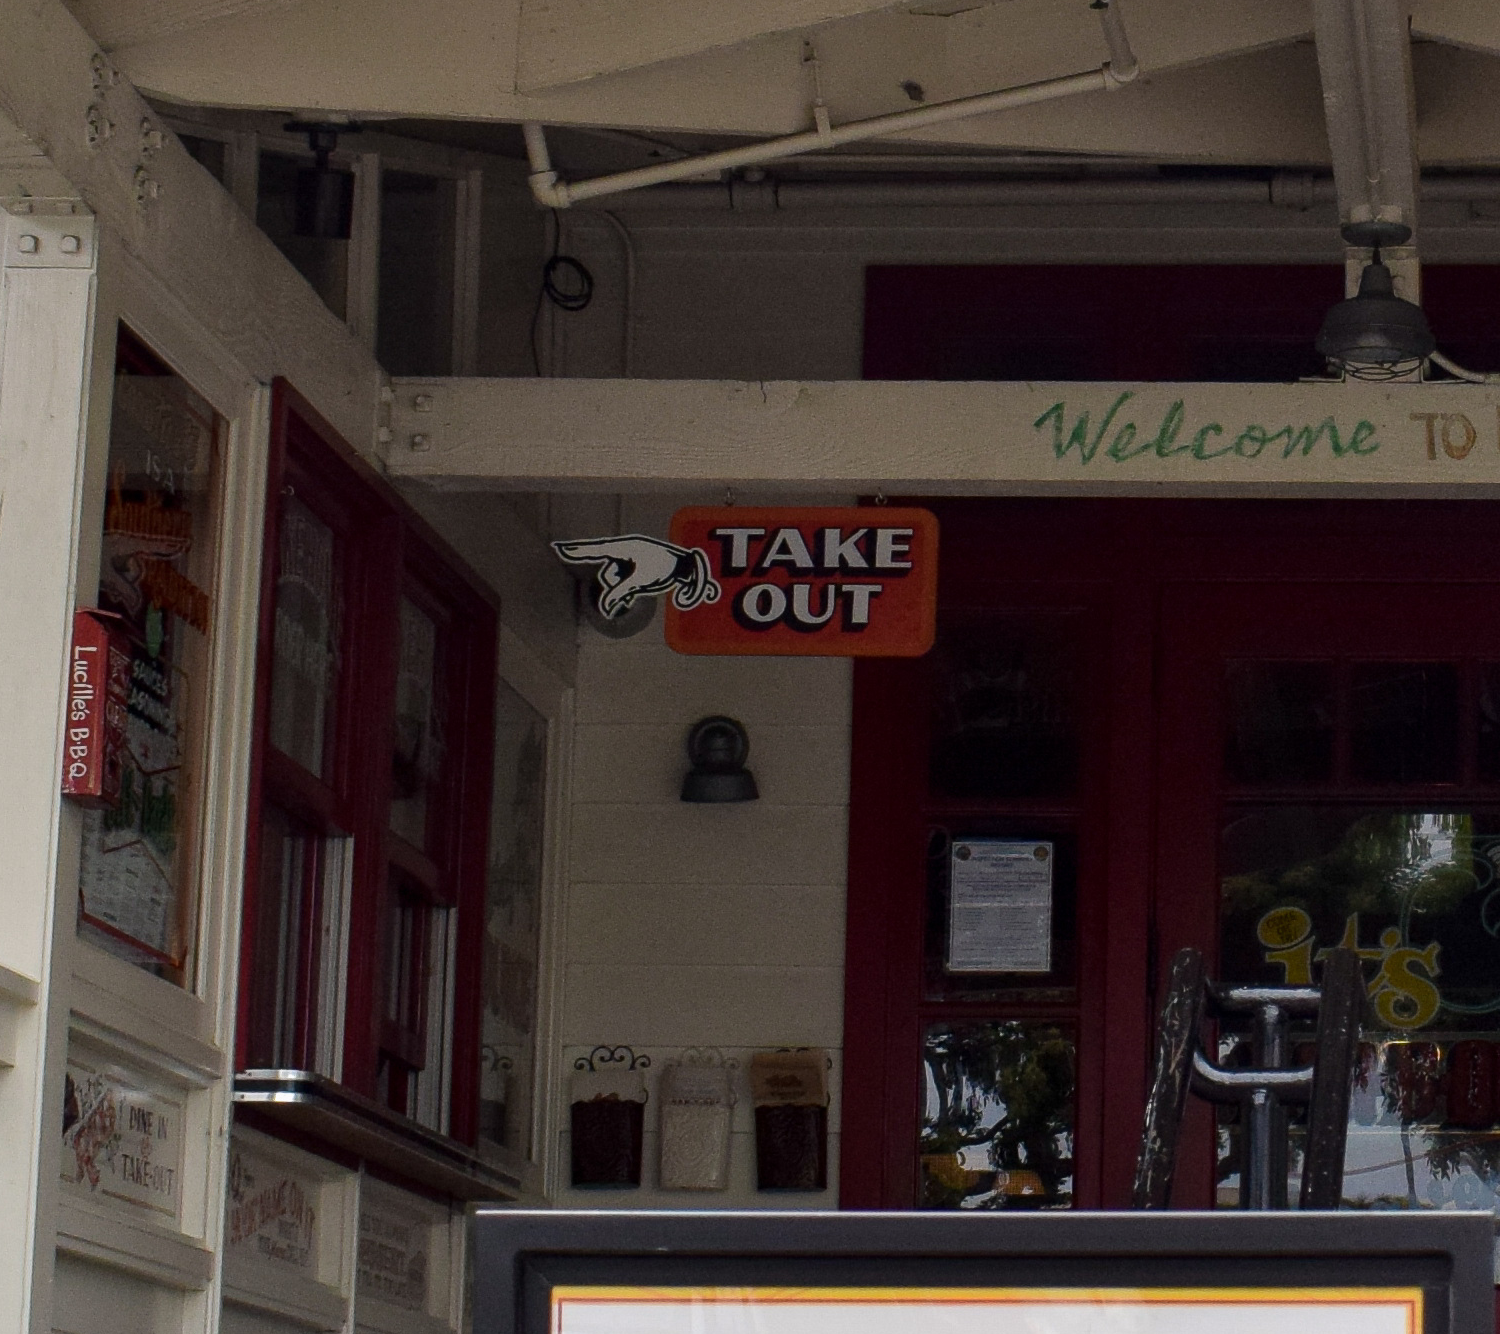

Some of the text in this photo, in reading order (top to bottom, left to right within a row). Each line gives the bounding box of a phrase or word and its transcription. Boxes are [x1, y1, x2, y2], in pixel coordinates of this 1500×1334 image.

[1033, 391, 1380, 464] Welcome
[1409, 412, 1477, 459] TO
[710, 527, 913, 573] TAKE
[741, 583, 882, 626] OUT
[71, 645, 97, 721] Lucille's
[130, 1105, 153, 1136] DINE
